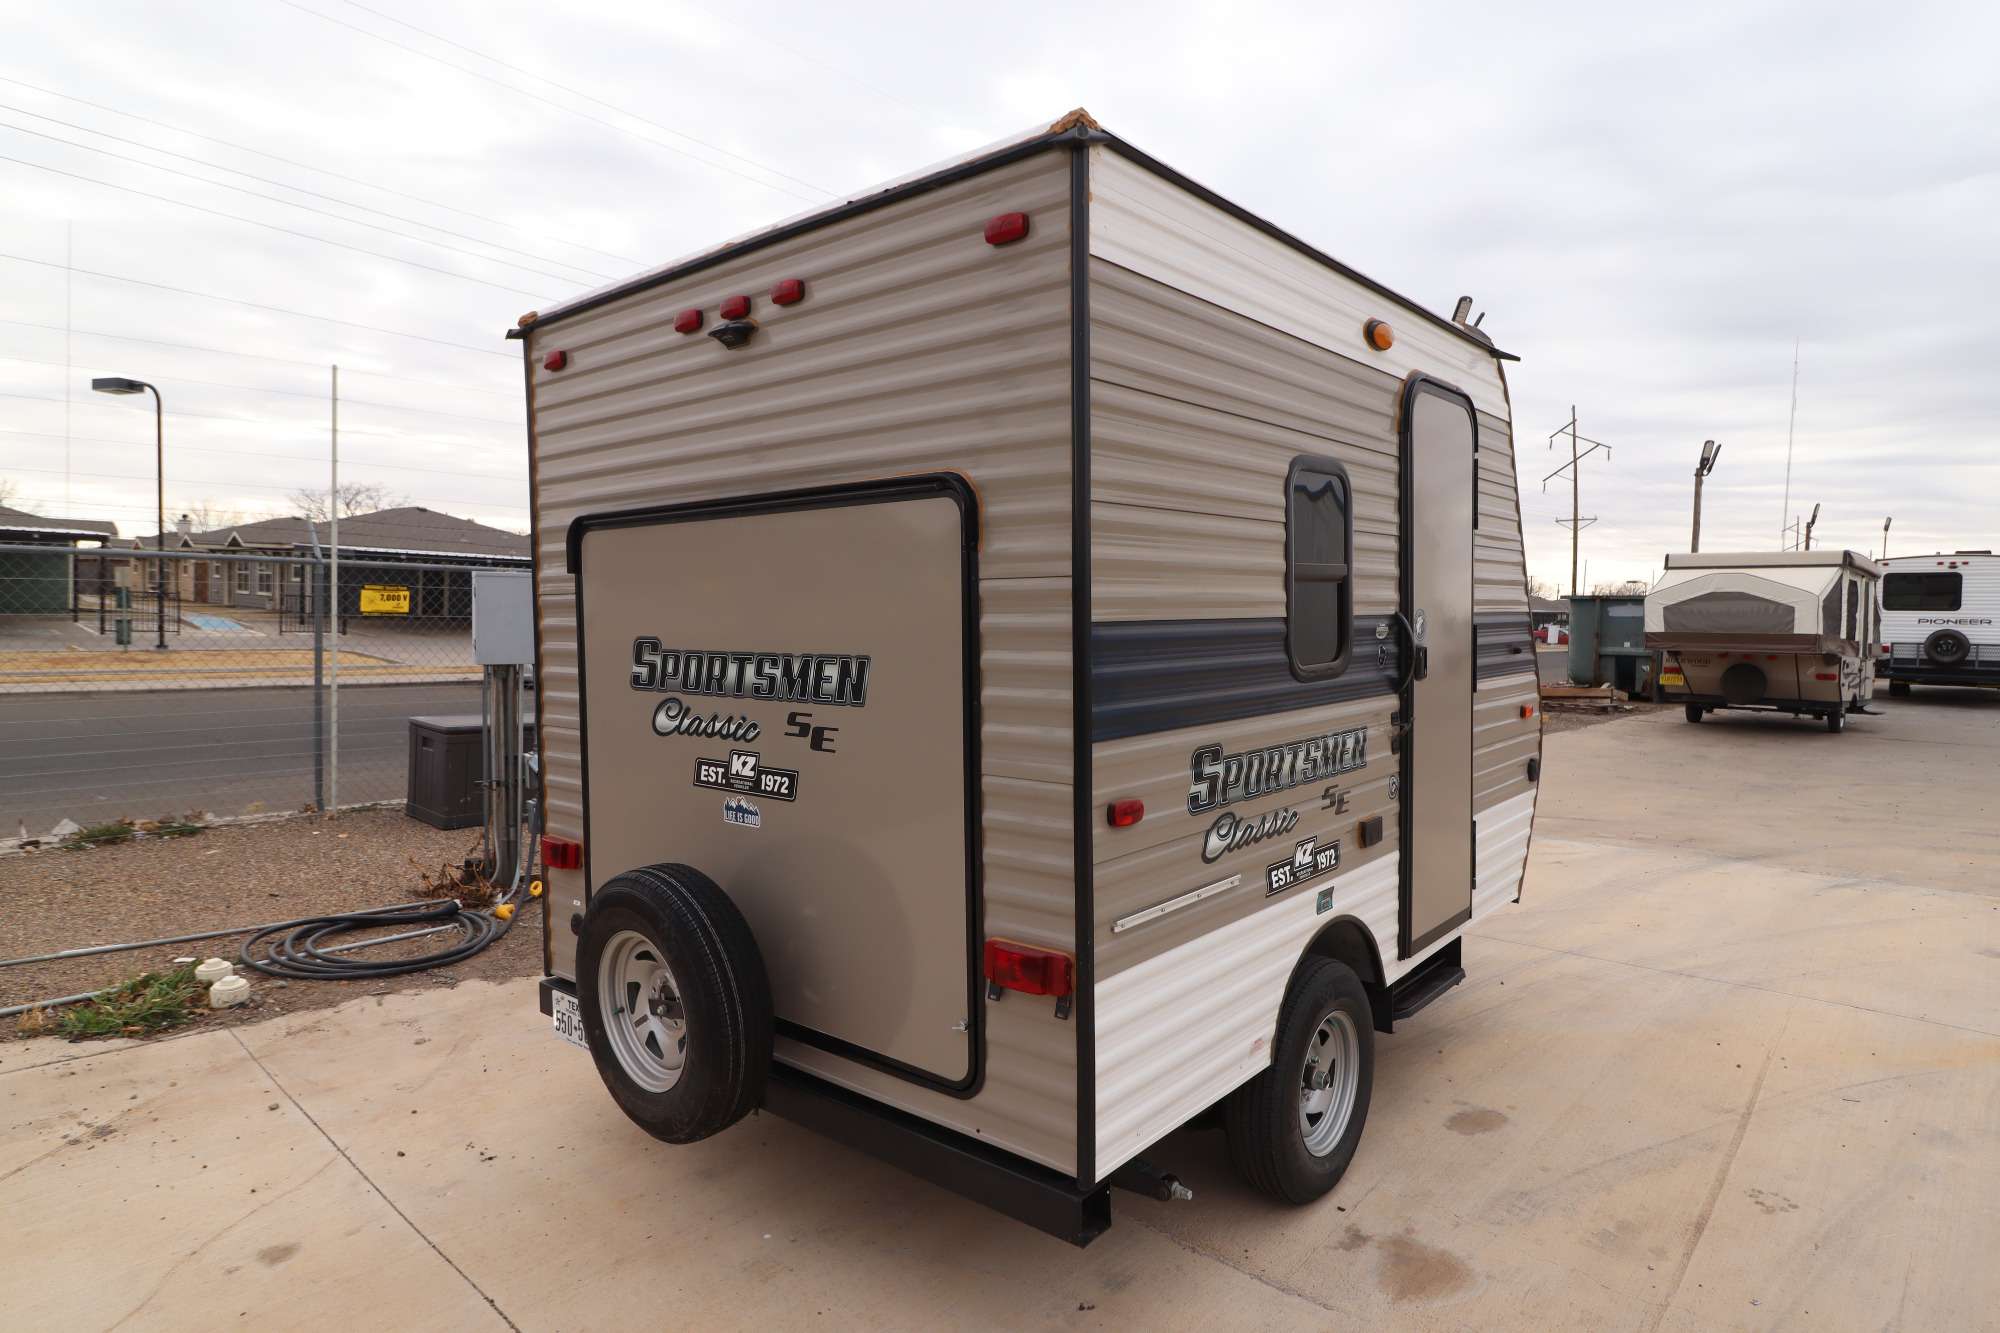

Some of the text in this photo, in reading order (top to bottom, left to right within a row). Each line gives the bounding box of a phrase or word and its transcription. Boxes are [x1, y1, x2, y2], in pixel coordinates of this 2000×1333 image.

[631, 636, 871, 707] SPORTSMEN
[652, 698, 840, 753] Classic SE
[700, 765, 726, 784] EST.
[760, 774, 790, 794] 1972
[731, 754, 757, 777] KZ
[1187, 726, 1368, 816] SPORTSMEN
[1201, 807, 1300, 864] Classic
[1295, 841, 1315, 867] KZ
[1271, 865, 1294, 889] EST.
[1316, 848, 1336, 870] 1972
